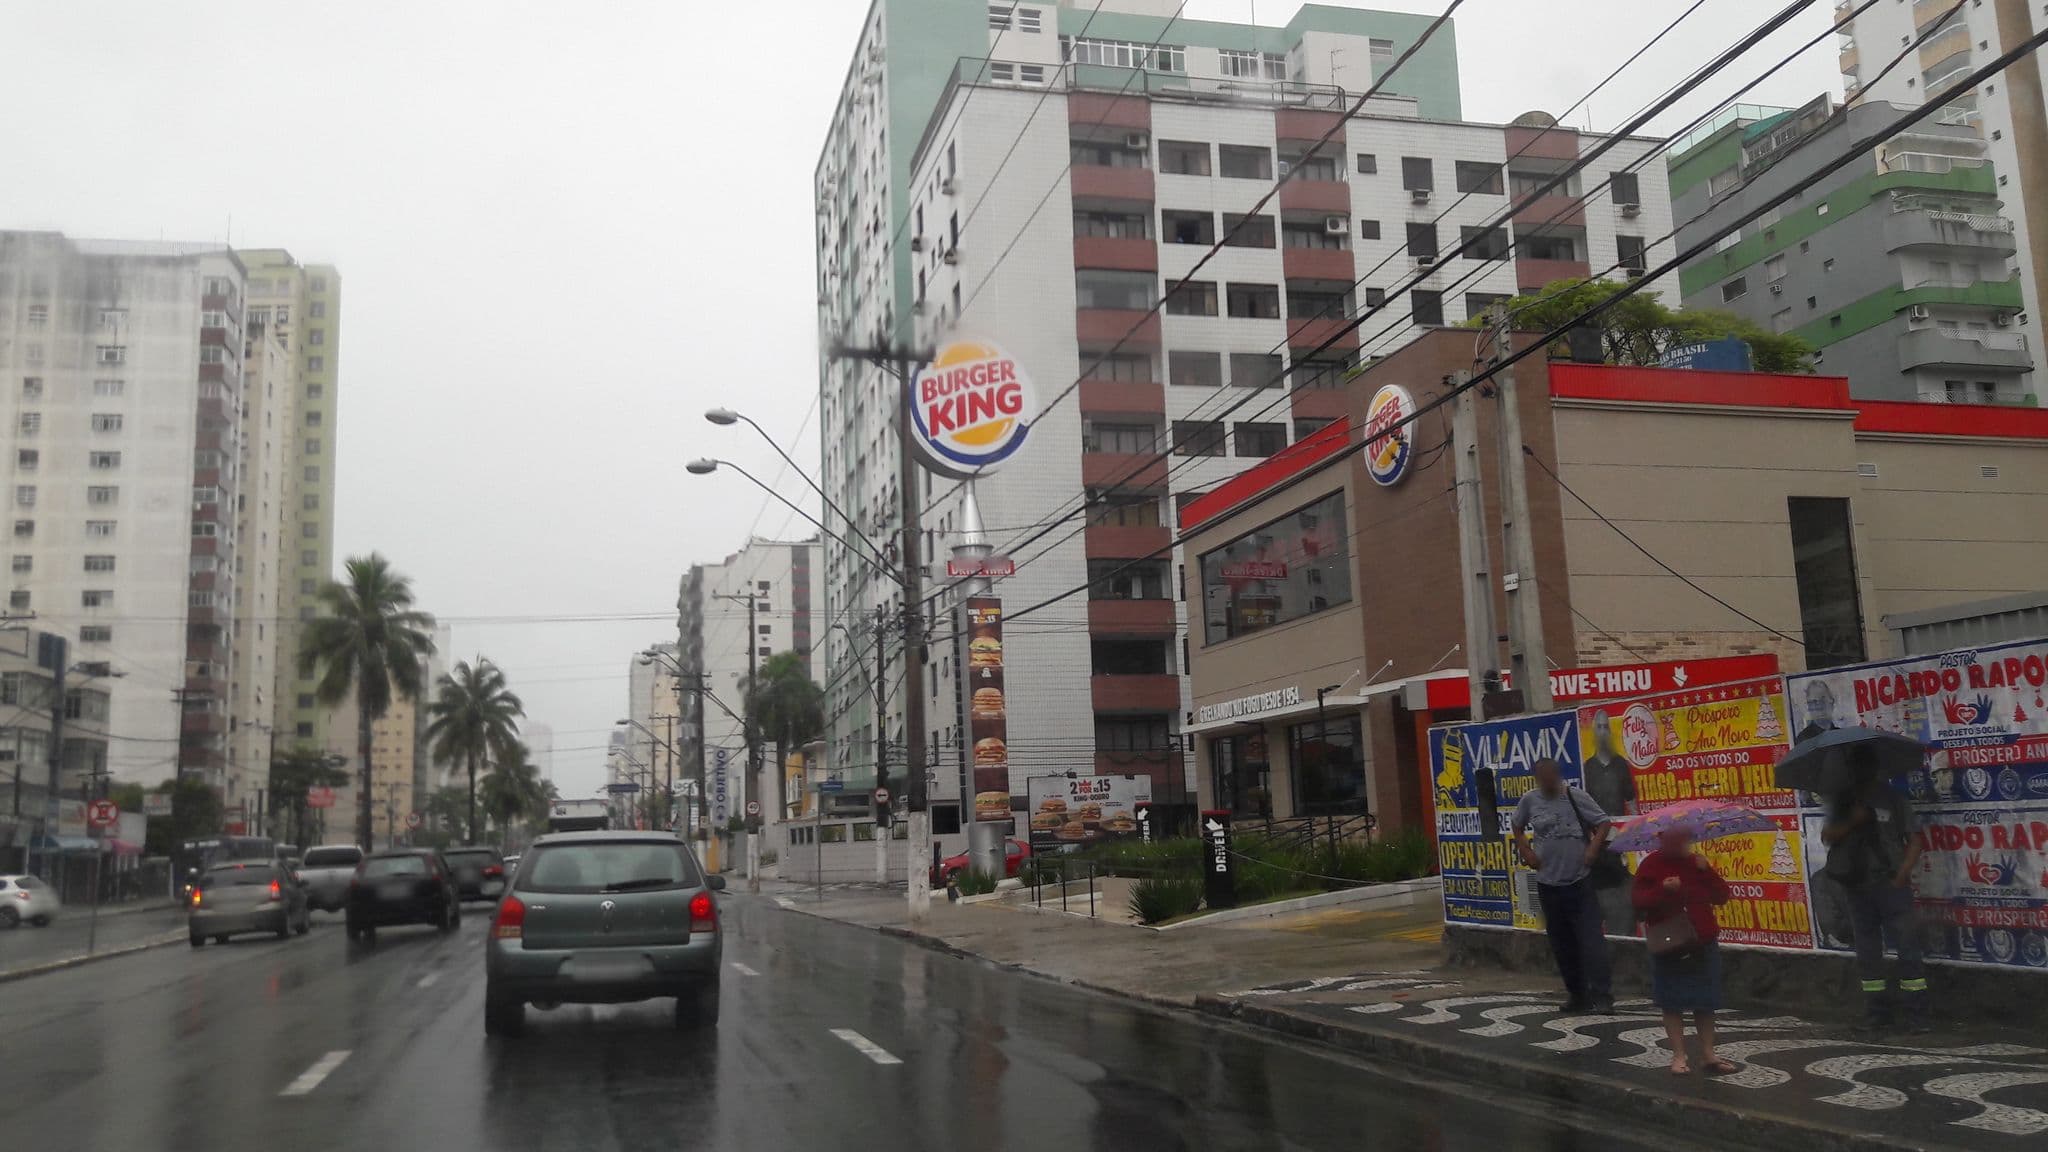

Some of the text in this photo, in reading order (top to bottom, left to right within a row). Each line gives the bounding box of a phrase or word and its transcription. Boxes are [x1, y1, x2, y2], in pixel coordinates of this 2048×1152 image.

[1670, 343, 1709, 360] BRASIL
[921, 360, 1016, 404] BURGER
[929, 383, 1023, 438] KING
[1940, 651, 1977, 669] PASTOR
[1549, 669, 1652, 698] RIVE-THRU
[1853, 654, 2048, 714] RICARDO RAPO
[1282, 685, 1300, 706] 1954
[1622, 714, 1648, 738] Feliz
[1938, 725, 2007, 737] PROJETO SOCIAL
[1463, 720, 1573, 771] VILLAMIX
[1631, 740, 1659, 760] Natal
[1686, 724, 1750, 753] Ano Novo
[1943, 736, 2005, 749] DESEJA A TODOS
[1686, 755, 1699, 768] OS
[1700, 753, 1732, 767] VOTOS
[1735, 751, 1750, 764] DO
[716, 750, 726, 802] OBJETIVO
[1501, 775, 1539, 798] PRIVAT
[1636, 772, 1677, 804] TIAGO
[1693, 765, 1740, 799] FERRO
[1069, 782, 1079, 795] 2
[1214, 837, 1227, 872] DRIVE
[1440, 842, 1475, 870] OPEN
[1477, 842, 1506, 871] BAR
[1732, 857, 1764, 879] Novo
[1747, 884, 1763, 898] DO
[1715, 899, 1810, 932] ERRO VELHO
[1718, 929, 1733, 941] DOS
[1733, 930, 1748, 941] COM
[1770, 934, 1782, 945] PAZ
